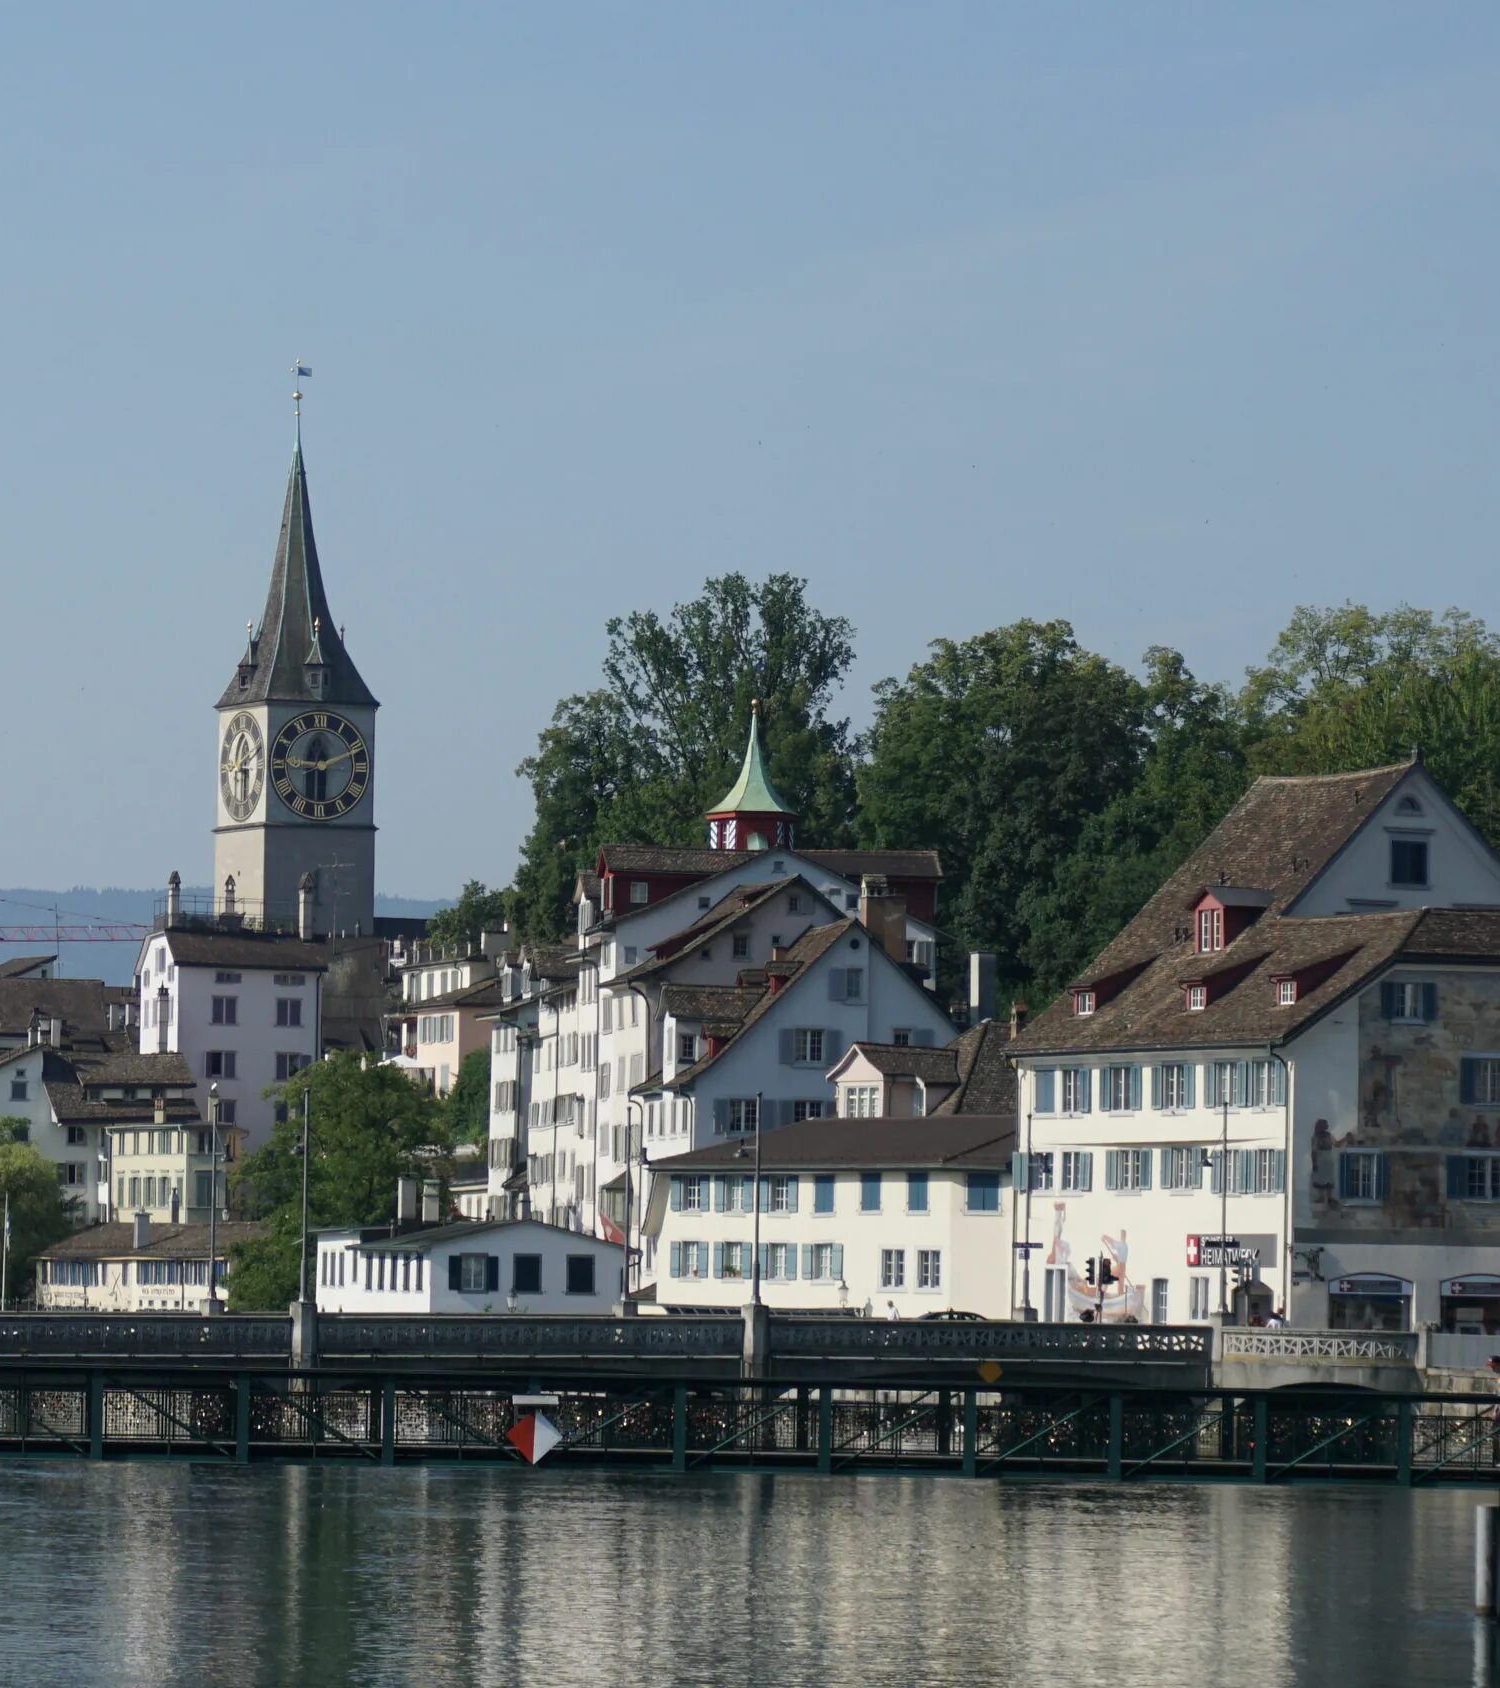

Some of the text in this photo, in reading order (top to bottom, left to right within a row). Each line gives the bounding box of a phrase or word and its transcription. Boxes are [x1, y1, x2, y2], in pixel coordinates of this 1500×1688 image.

[294, 719, 306, 733] XI
[314, 714, 327, 728] XII
[355, 762, 367, 773] III
